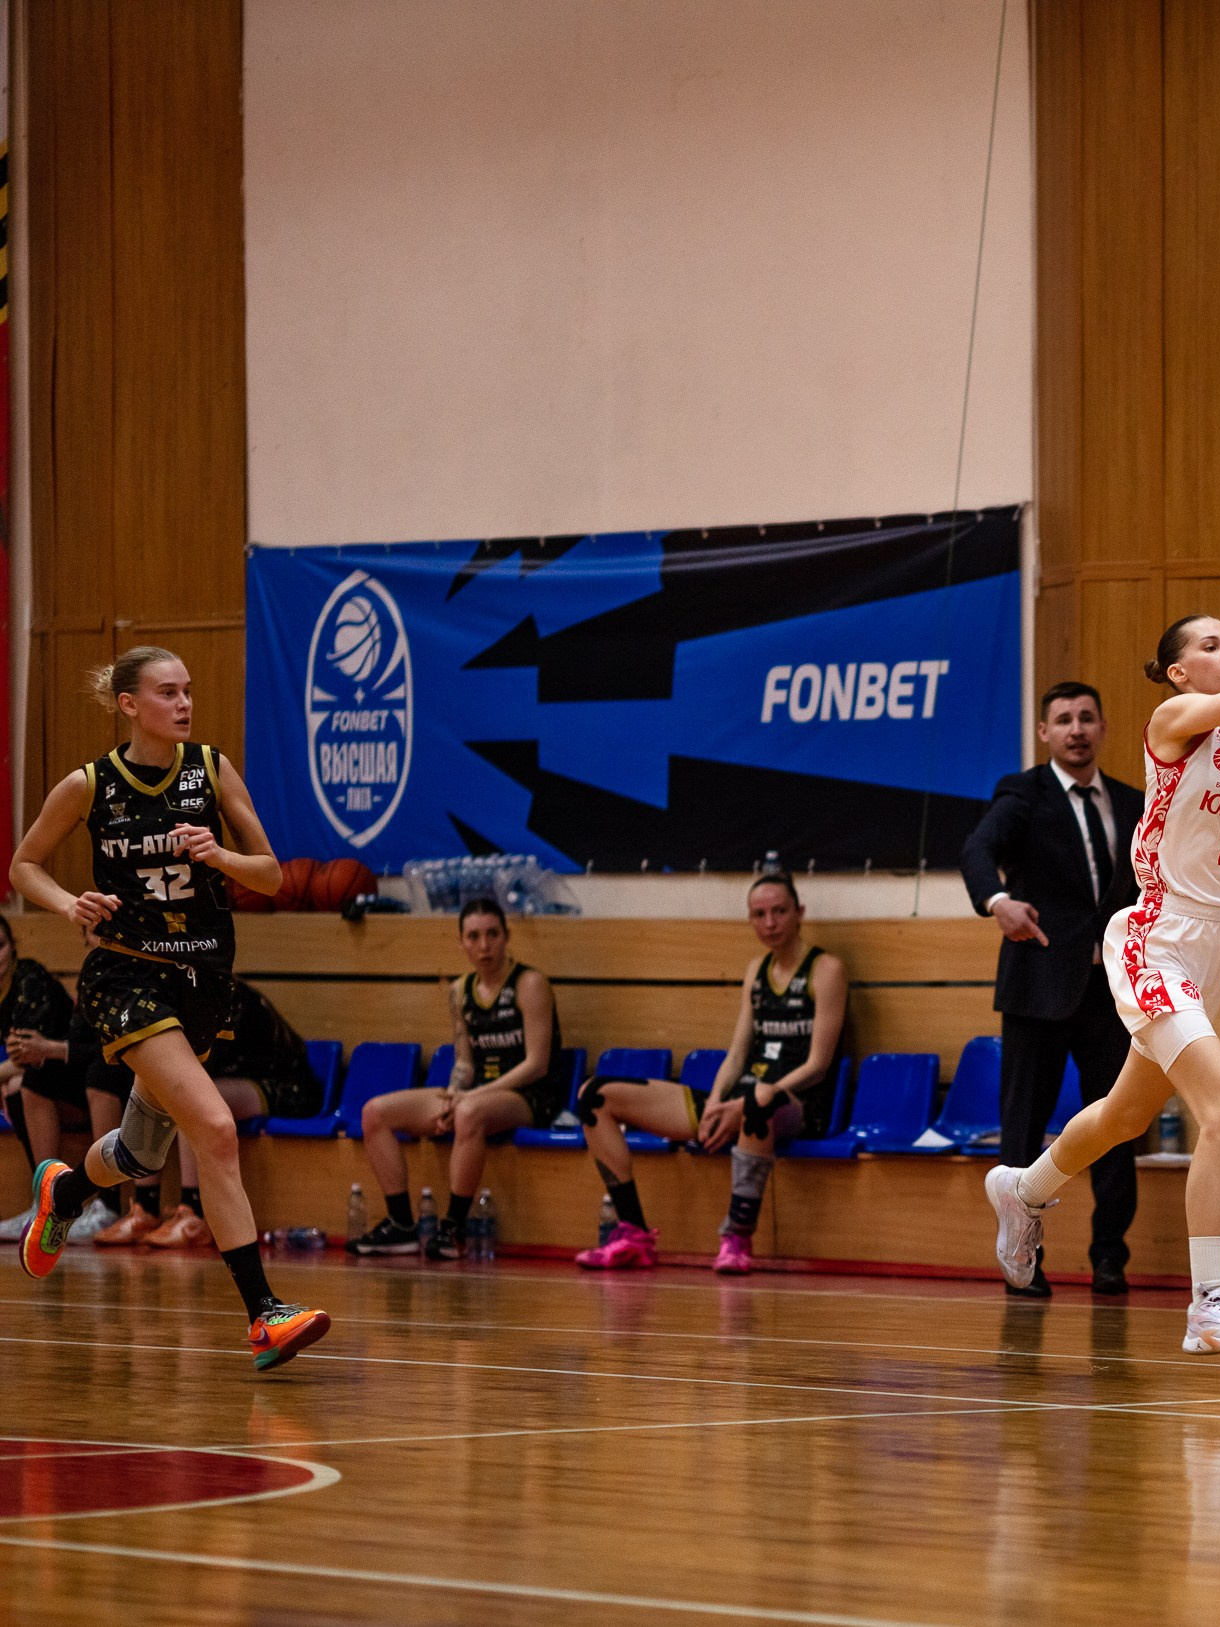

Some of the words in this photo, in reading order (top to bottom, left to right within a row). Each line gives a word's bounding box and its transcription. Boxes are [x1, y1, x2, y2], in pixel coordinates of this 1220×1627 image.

[761, 660, 949, 723] FONBET
[331, 709, 389, 732] FONBET
[320, 741, 397, 784] ВЫСШАЯ
[179, 779, 204, 791] BET
[180, 768, 205, 781] FON
[136, 864, 195, 901] 32
[141, 938, 218, 953] ХИМПРОМ
